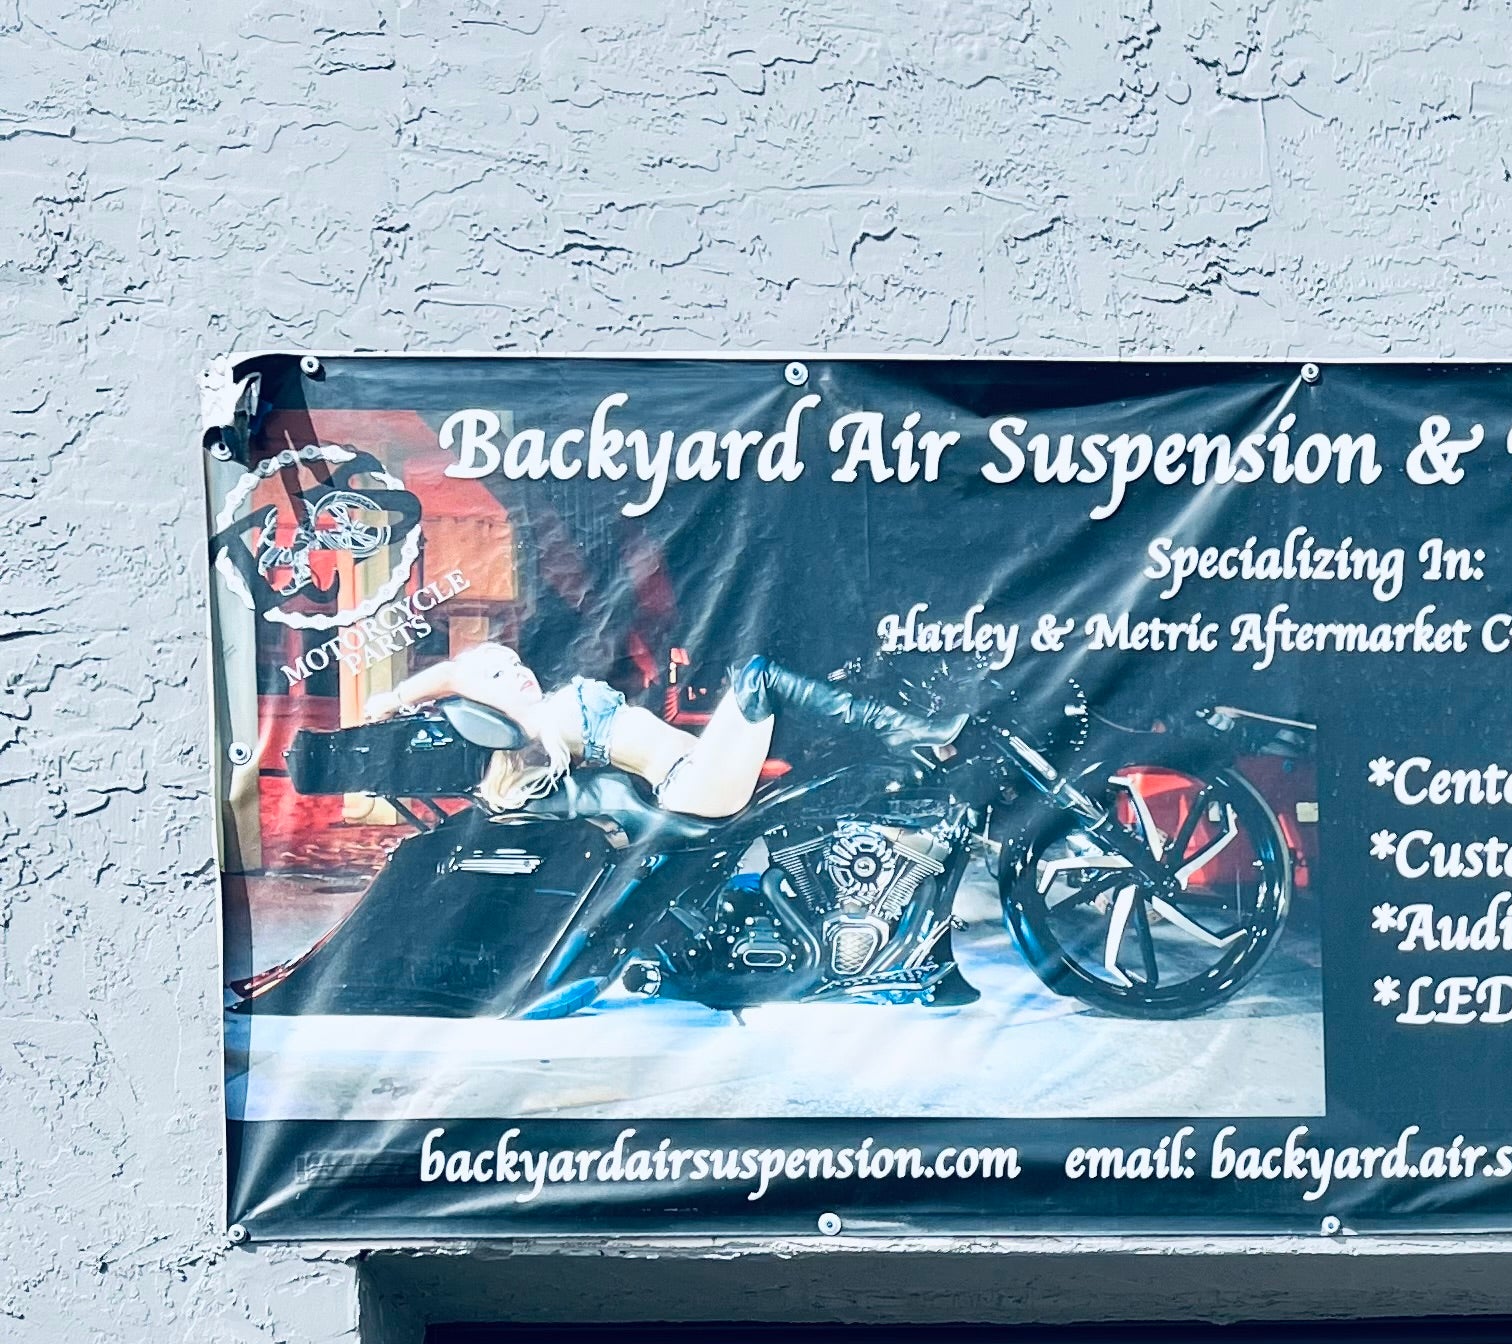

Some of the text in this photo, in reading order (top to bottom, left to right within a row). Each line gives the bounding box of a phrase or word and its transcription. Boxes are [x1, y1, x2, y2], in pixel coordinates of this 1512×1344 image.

[437, 392, 821, 517] Backyard
[828, 411, 961, 483] Air
[980, 411, 1383, 520] Suspension
[1406, 415, 1485, 485] &
[1143, 525, 1486, 601] Specializing In:
[280, 569, 471, 687] MOTORCYCLE
[344, 614, 432, 676] PARTS
[876, 601, 1019, 671] Harley
[1030, 613, 1075, 652] &
[1084, 611, 1219, 654] Metric
[1230, 603, 1472, 671] Aftermarket
[420, 1127, 1021, 1202] backyardairsuspension.com
[1065, 1126, 1196, 1179] email:
